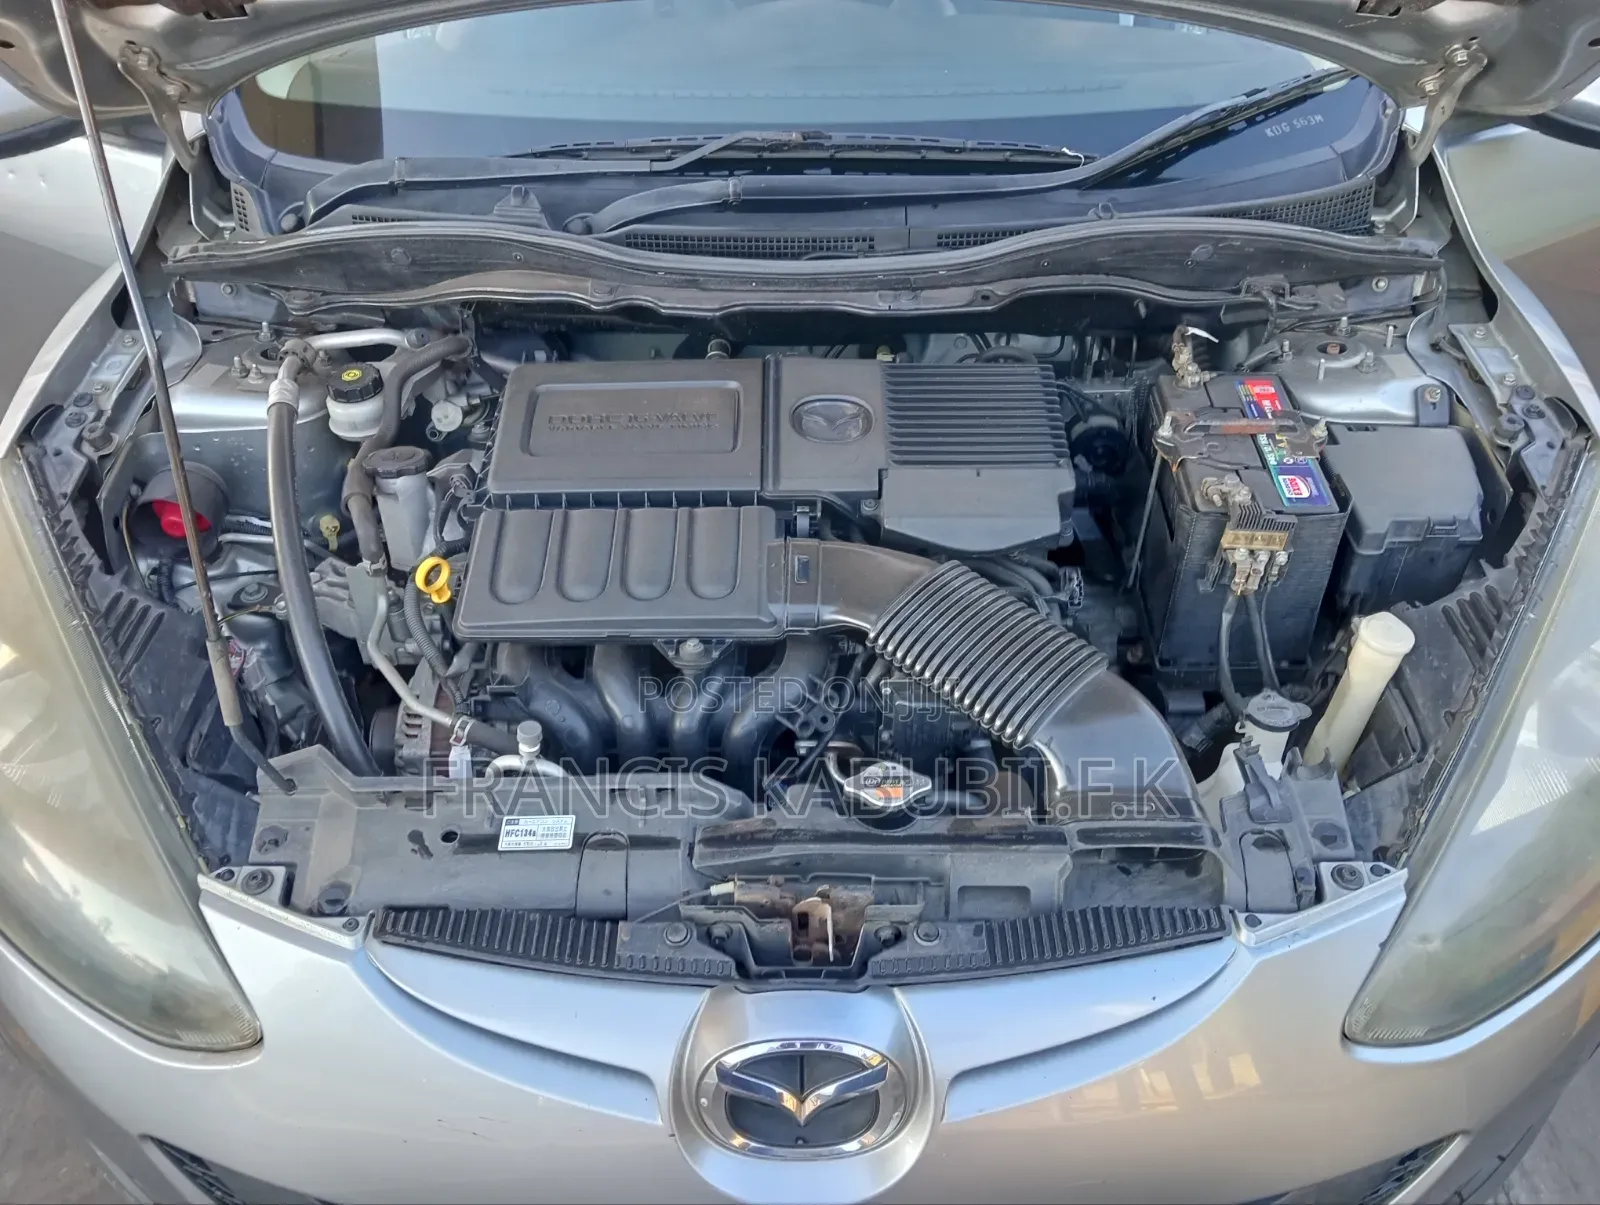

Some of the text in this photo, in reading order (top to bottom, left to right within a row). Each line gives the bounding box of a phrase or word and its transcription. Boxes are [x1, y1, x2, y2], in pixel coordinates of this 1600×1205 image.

[1264, 113, 1324, 138] KDG 563M
[504, 828, 537, 838] HFC134a
